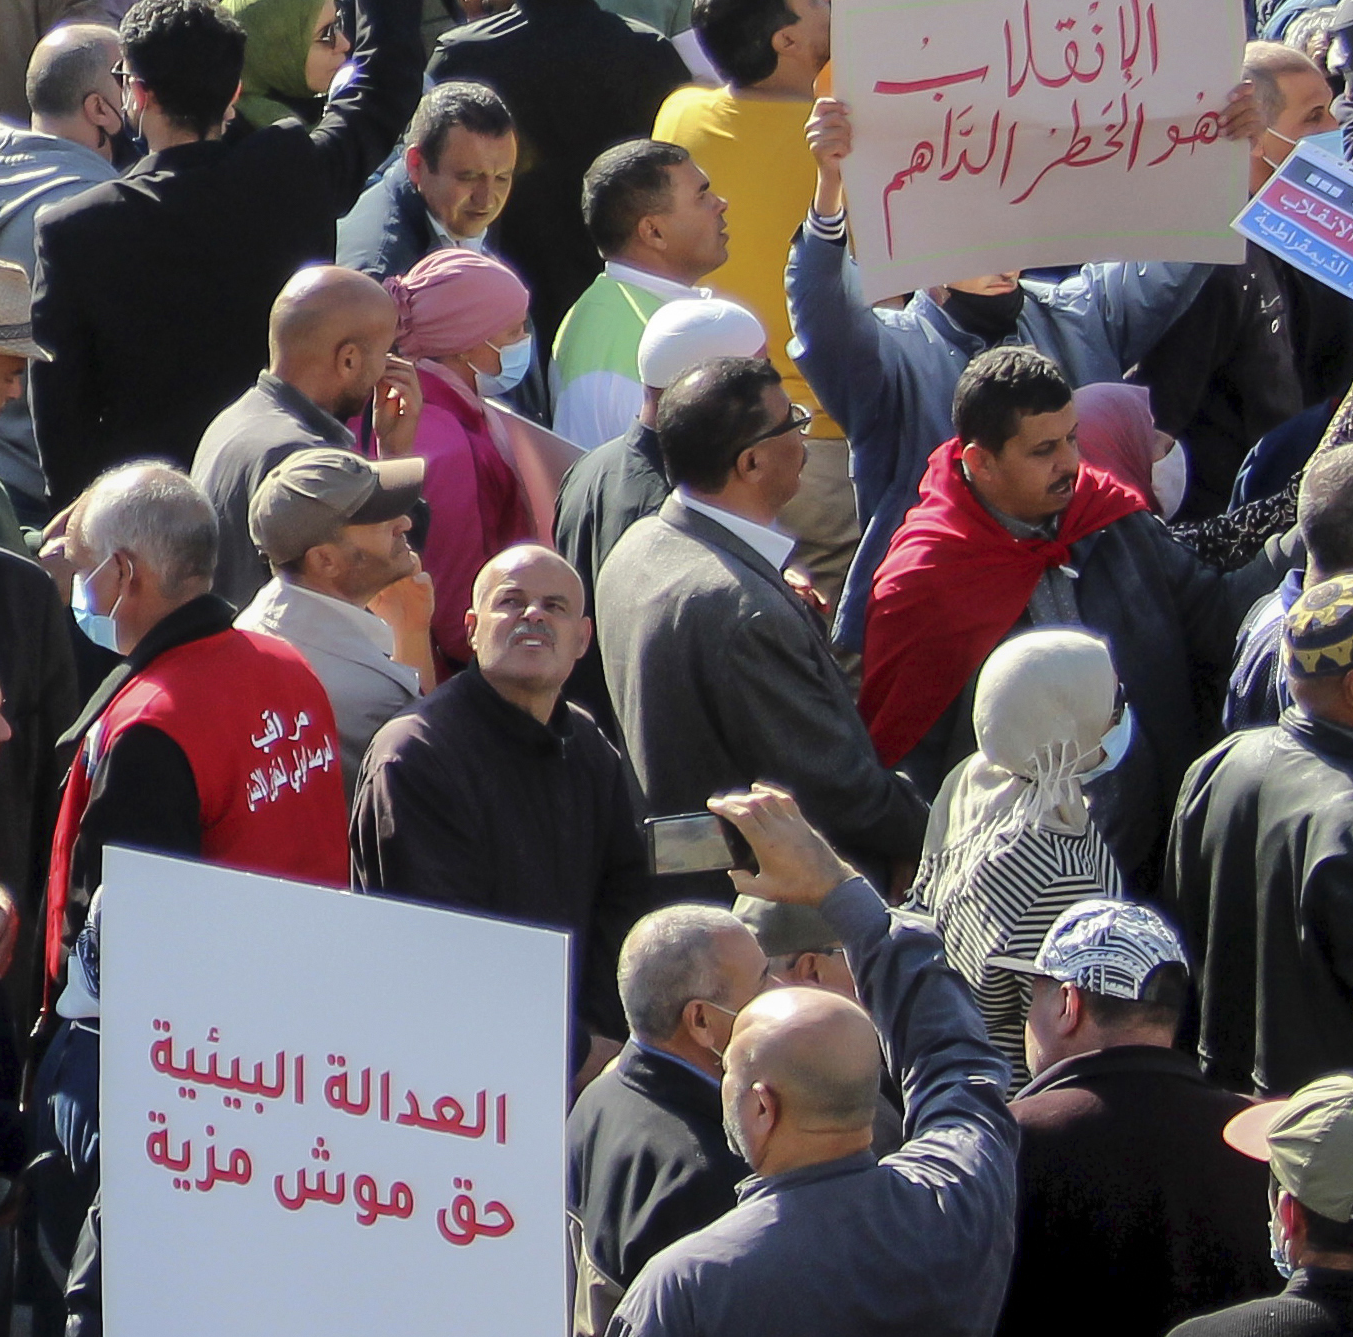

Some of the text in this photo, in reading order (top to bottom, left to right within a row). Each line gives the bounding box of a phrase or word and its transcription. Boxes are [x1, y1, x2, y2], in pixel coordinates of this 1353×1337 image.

[149, 1018, 507, 1146] العدالة البيئية
[145, 1109, 516, 1247] حق موش مزية
